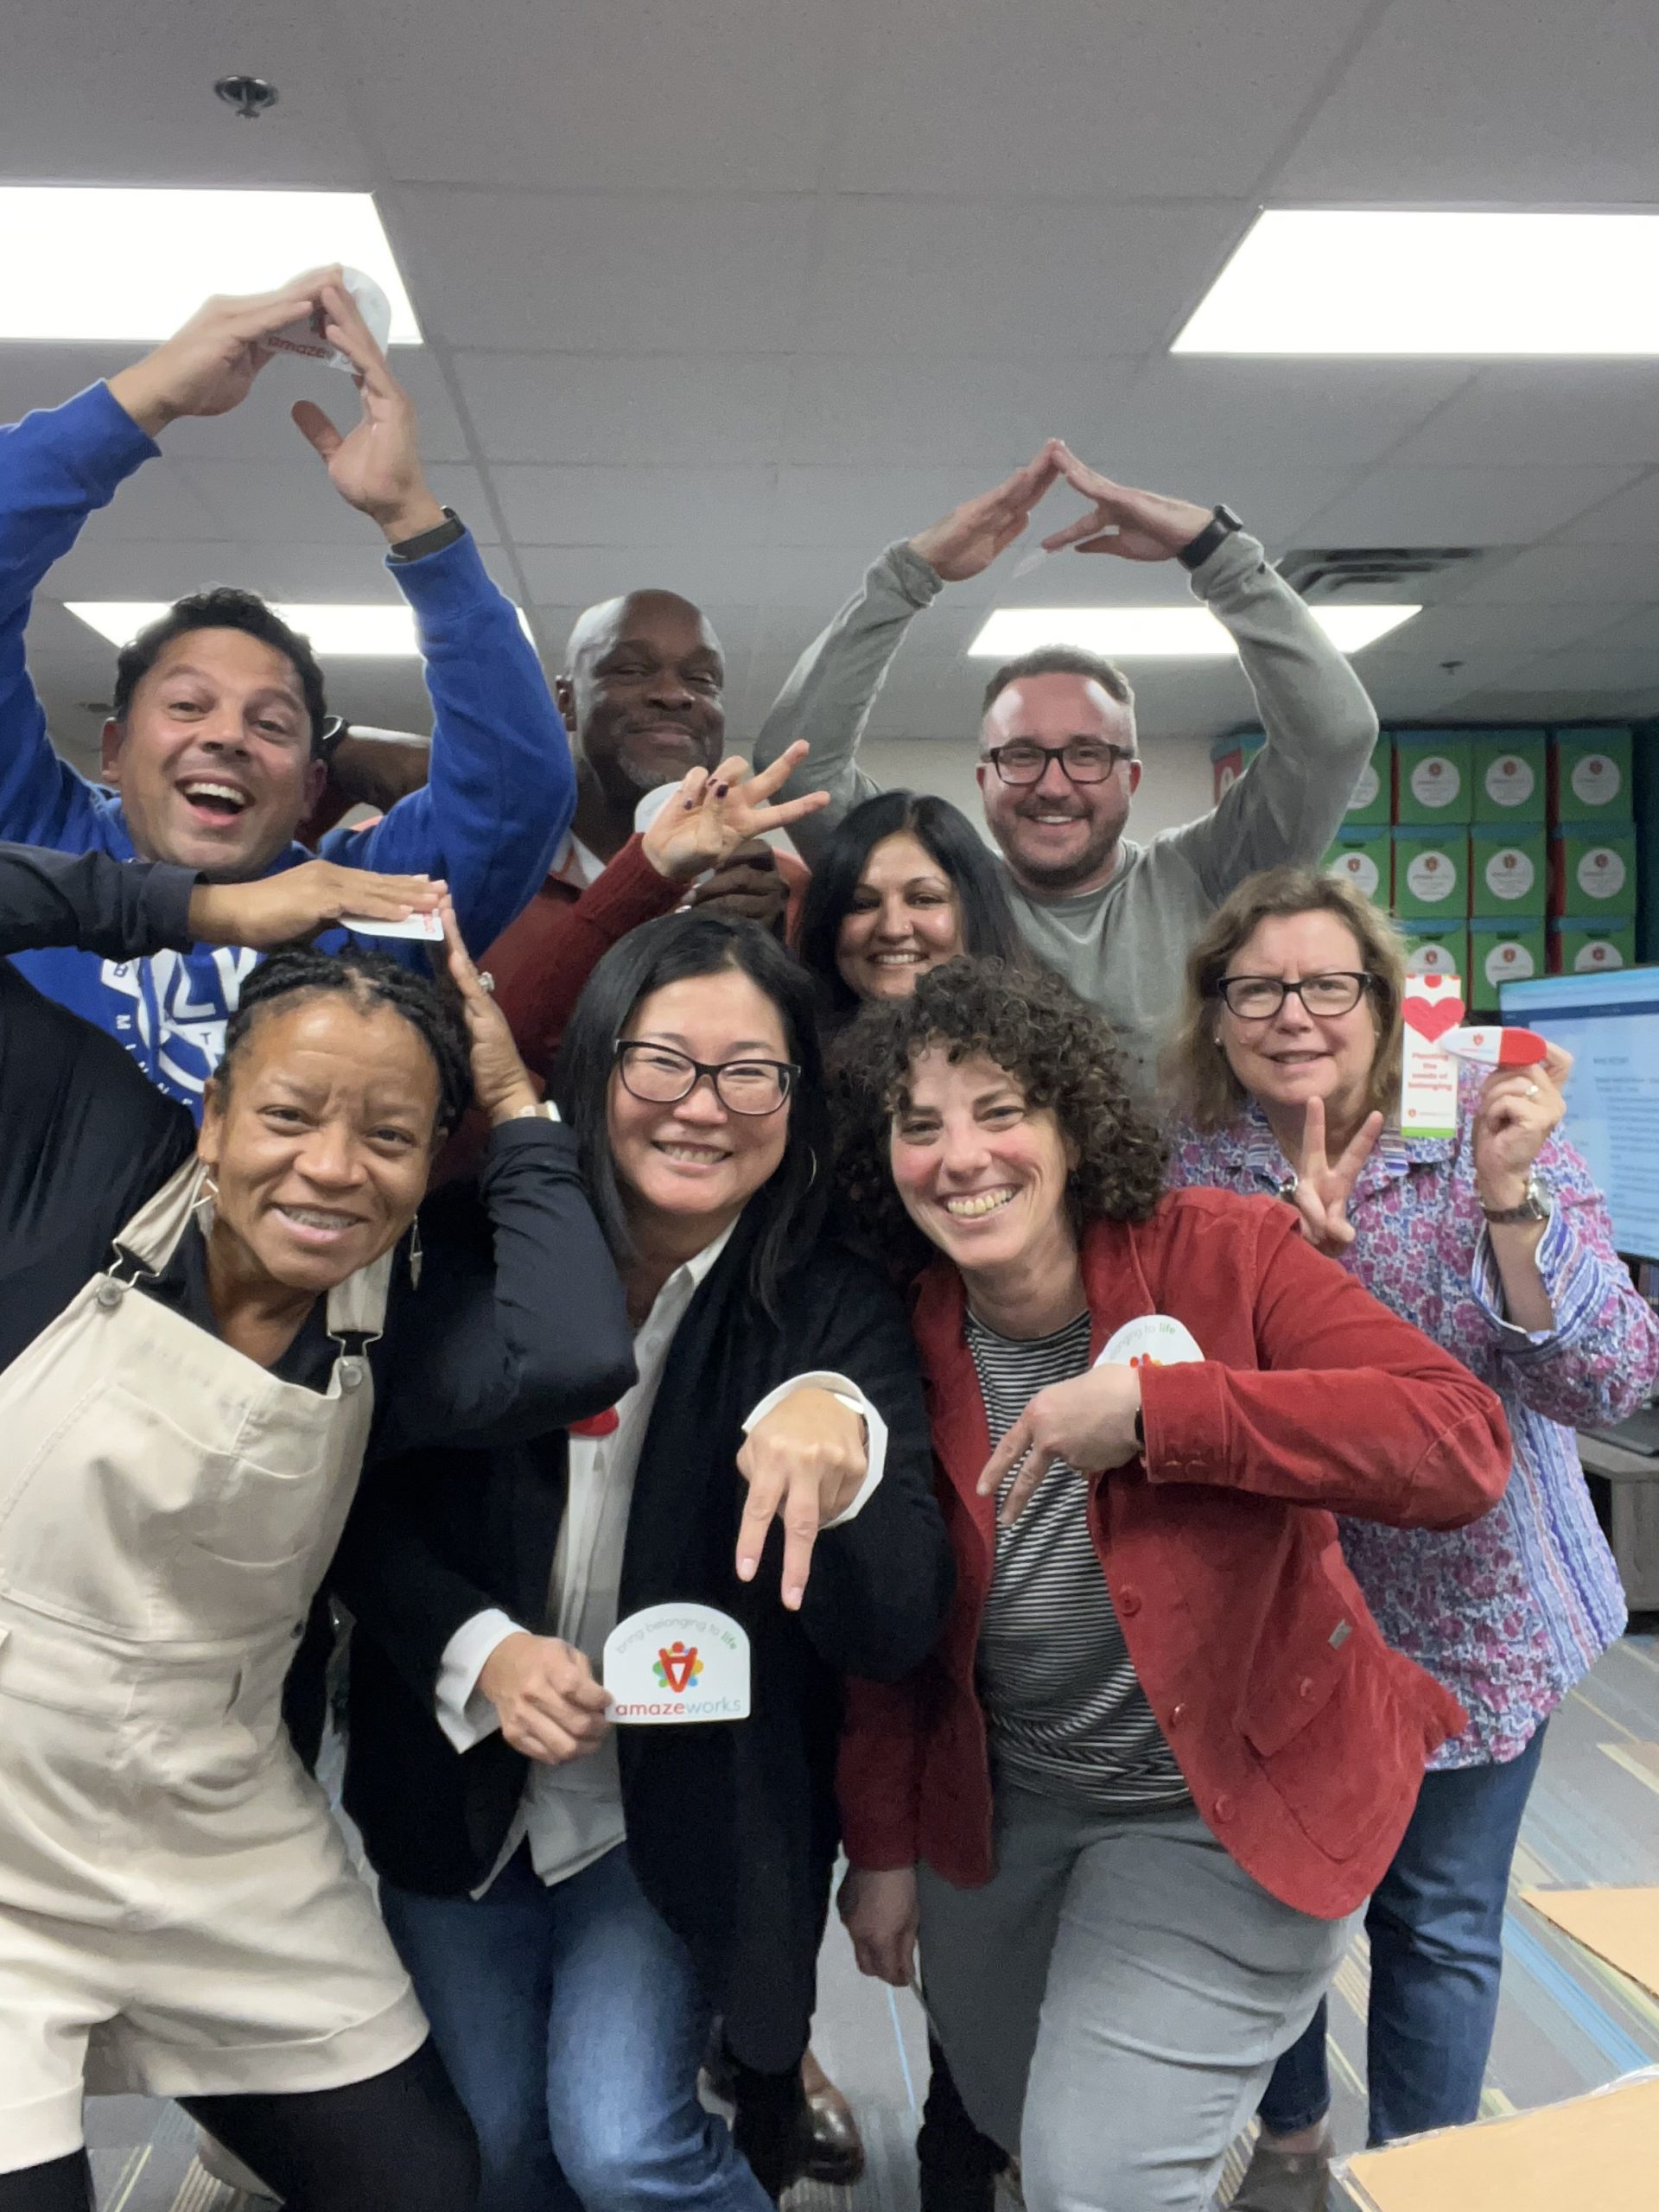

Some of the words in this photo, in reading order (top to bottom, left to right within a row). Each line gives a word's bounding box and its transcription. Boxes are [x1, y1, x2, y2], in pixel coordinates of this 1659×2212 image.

[1144, 1324, 1156, 1334] to
[1159, 1322, 1176, 1334] life
[615, 1628, 645, 1654] bring
[645, 1618, 708, 1633] belonging
[708, 1623, 720, 1636] to
[719, 1630, 737, 1649] life
[615, 1695, 741, 1716] amazeworks
